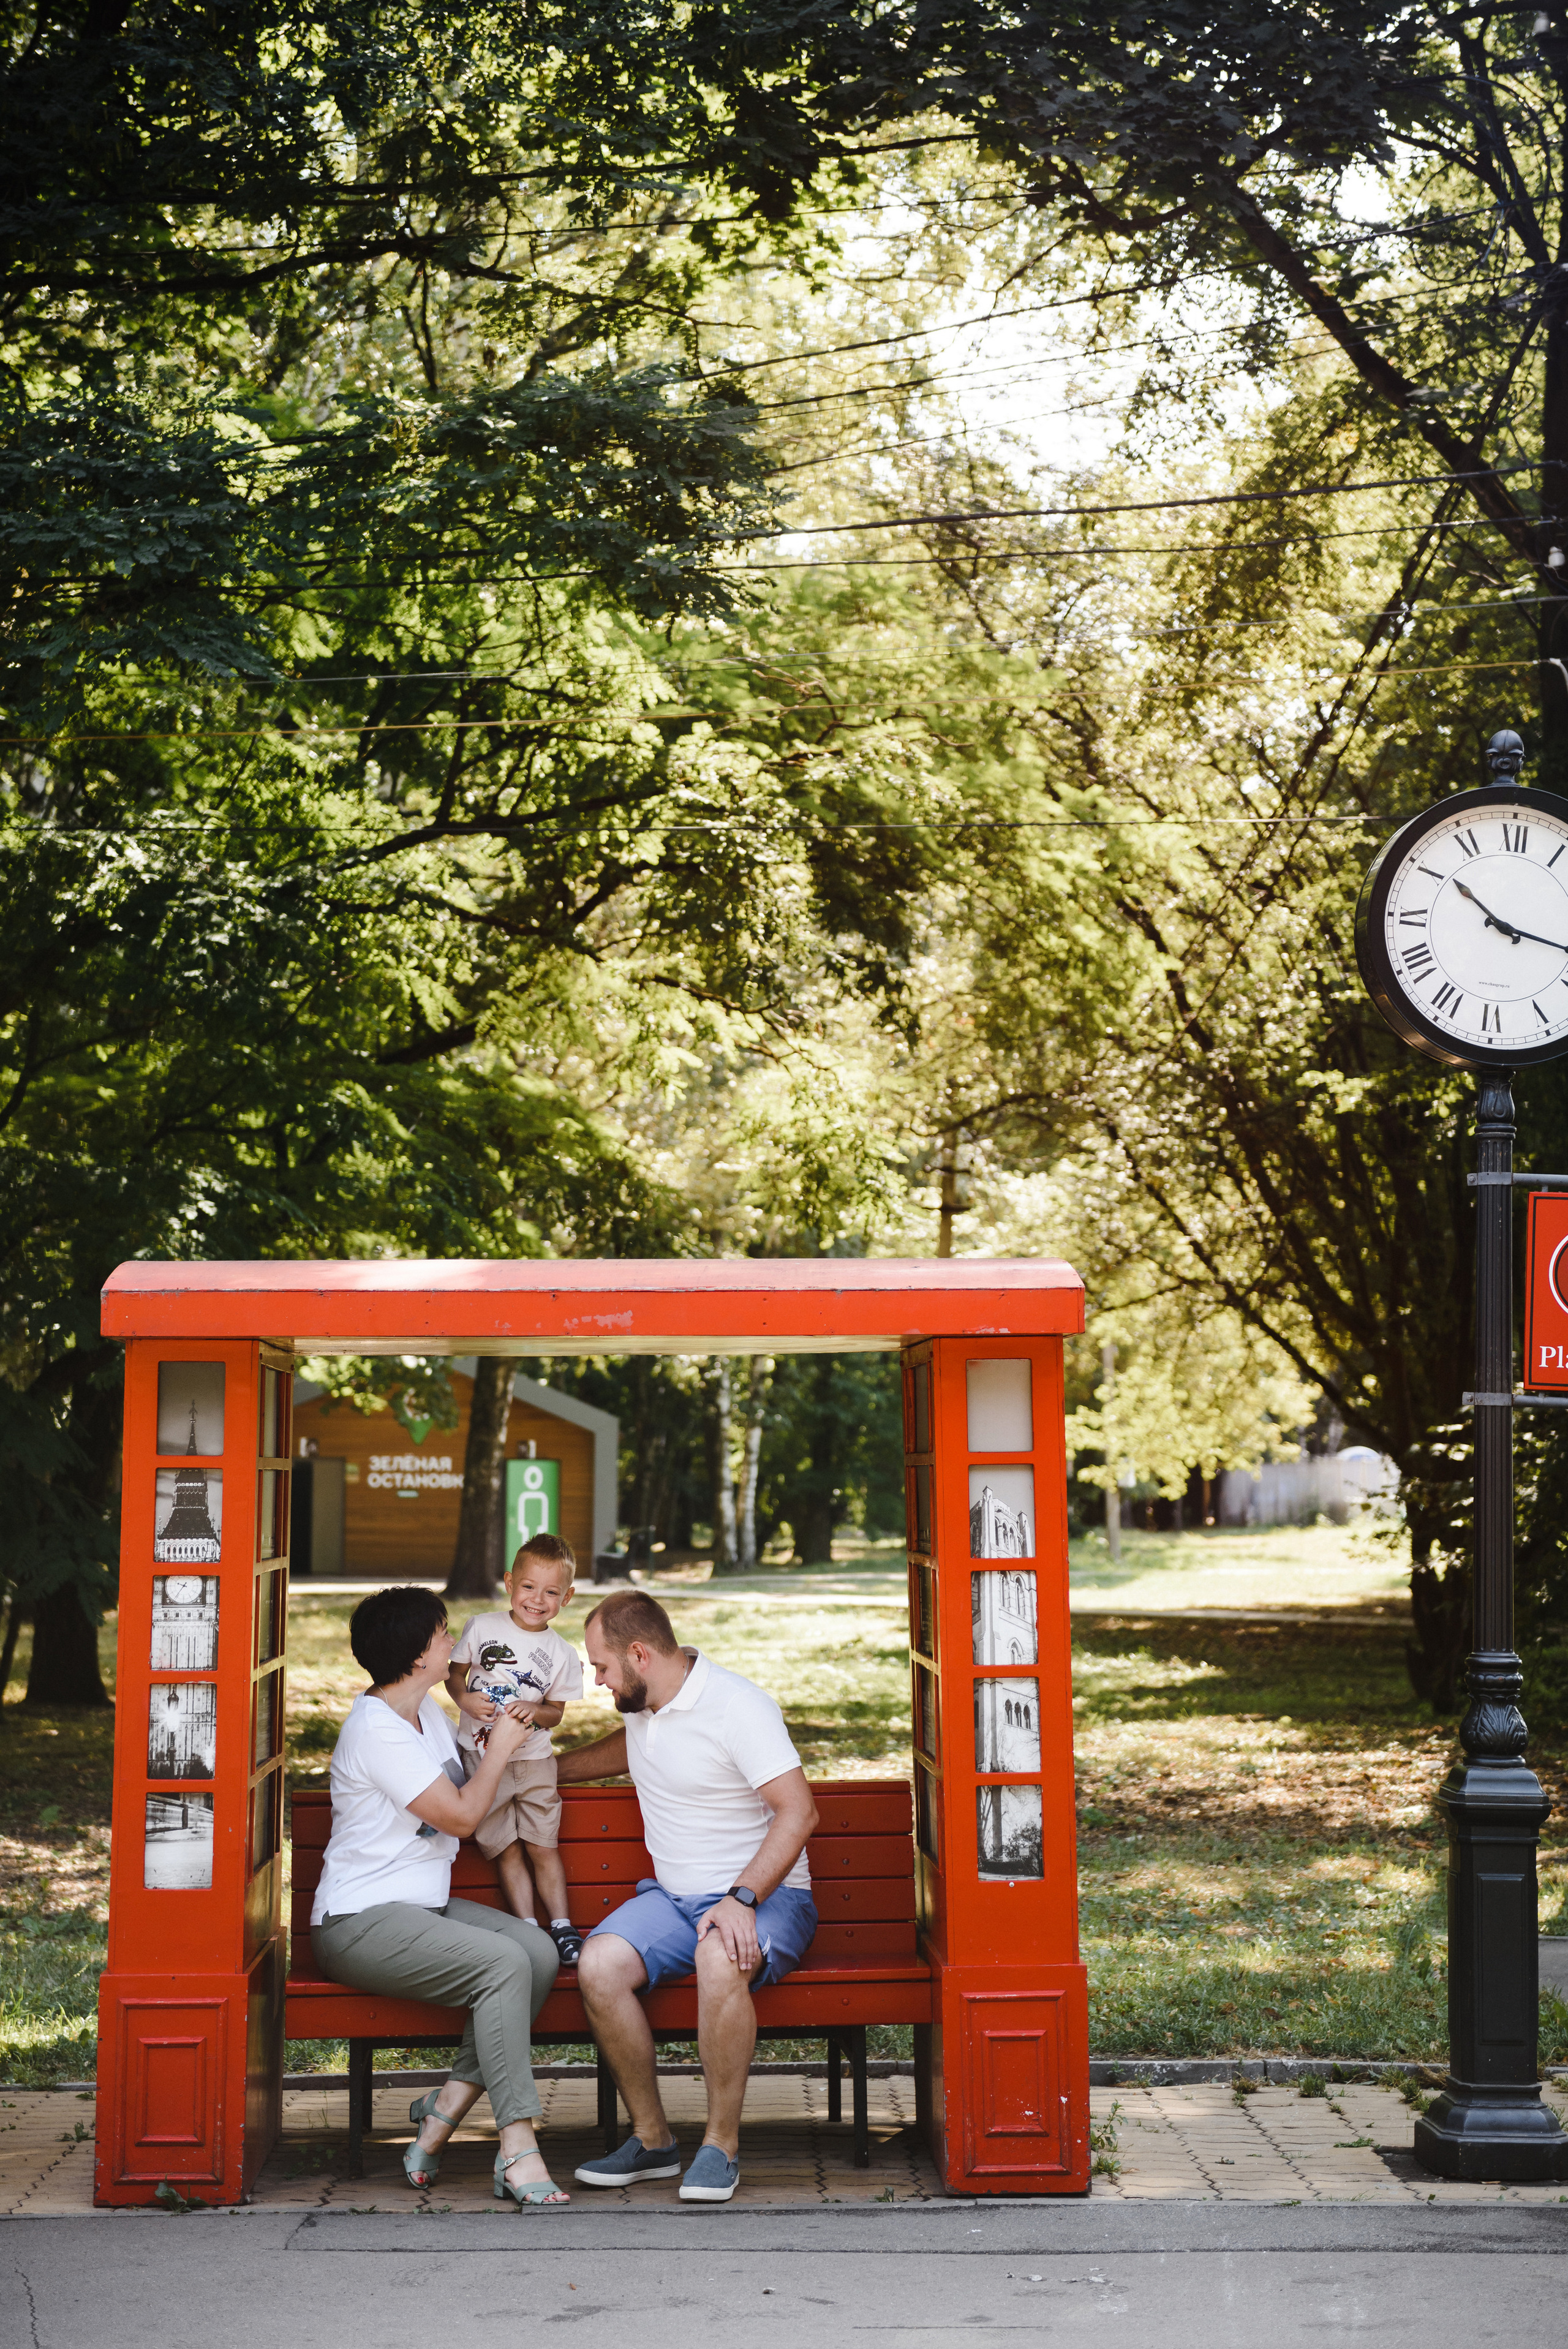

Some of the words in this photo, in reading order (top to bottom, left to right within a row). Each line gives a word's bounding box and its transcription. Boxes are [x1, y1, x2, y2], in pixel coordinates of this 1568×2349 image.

[1453, 828, 1482, 861] XI
[1499, 823, 1530, 853] XII
[1416, 861, 1446, 886] X
[369, 1455, 451, 1471] ЗЕЛЁНАЯ
[368, 1473, 464, 1488] ОСТАНОВК
[478, 1640, 498, 1654] CHAMELEON
[528, 1652, 550, 1676] FRIENDS
[535, 1648, 553, 1668] FIERCE
[533, 1675, 543, 1686] SHARK
